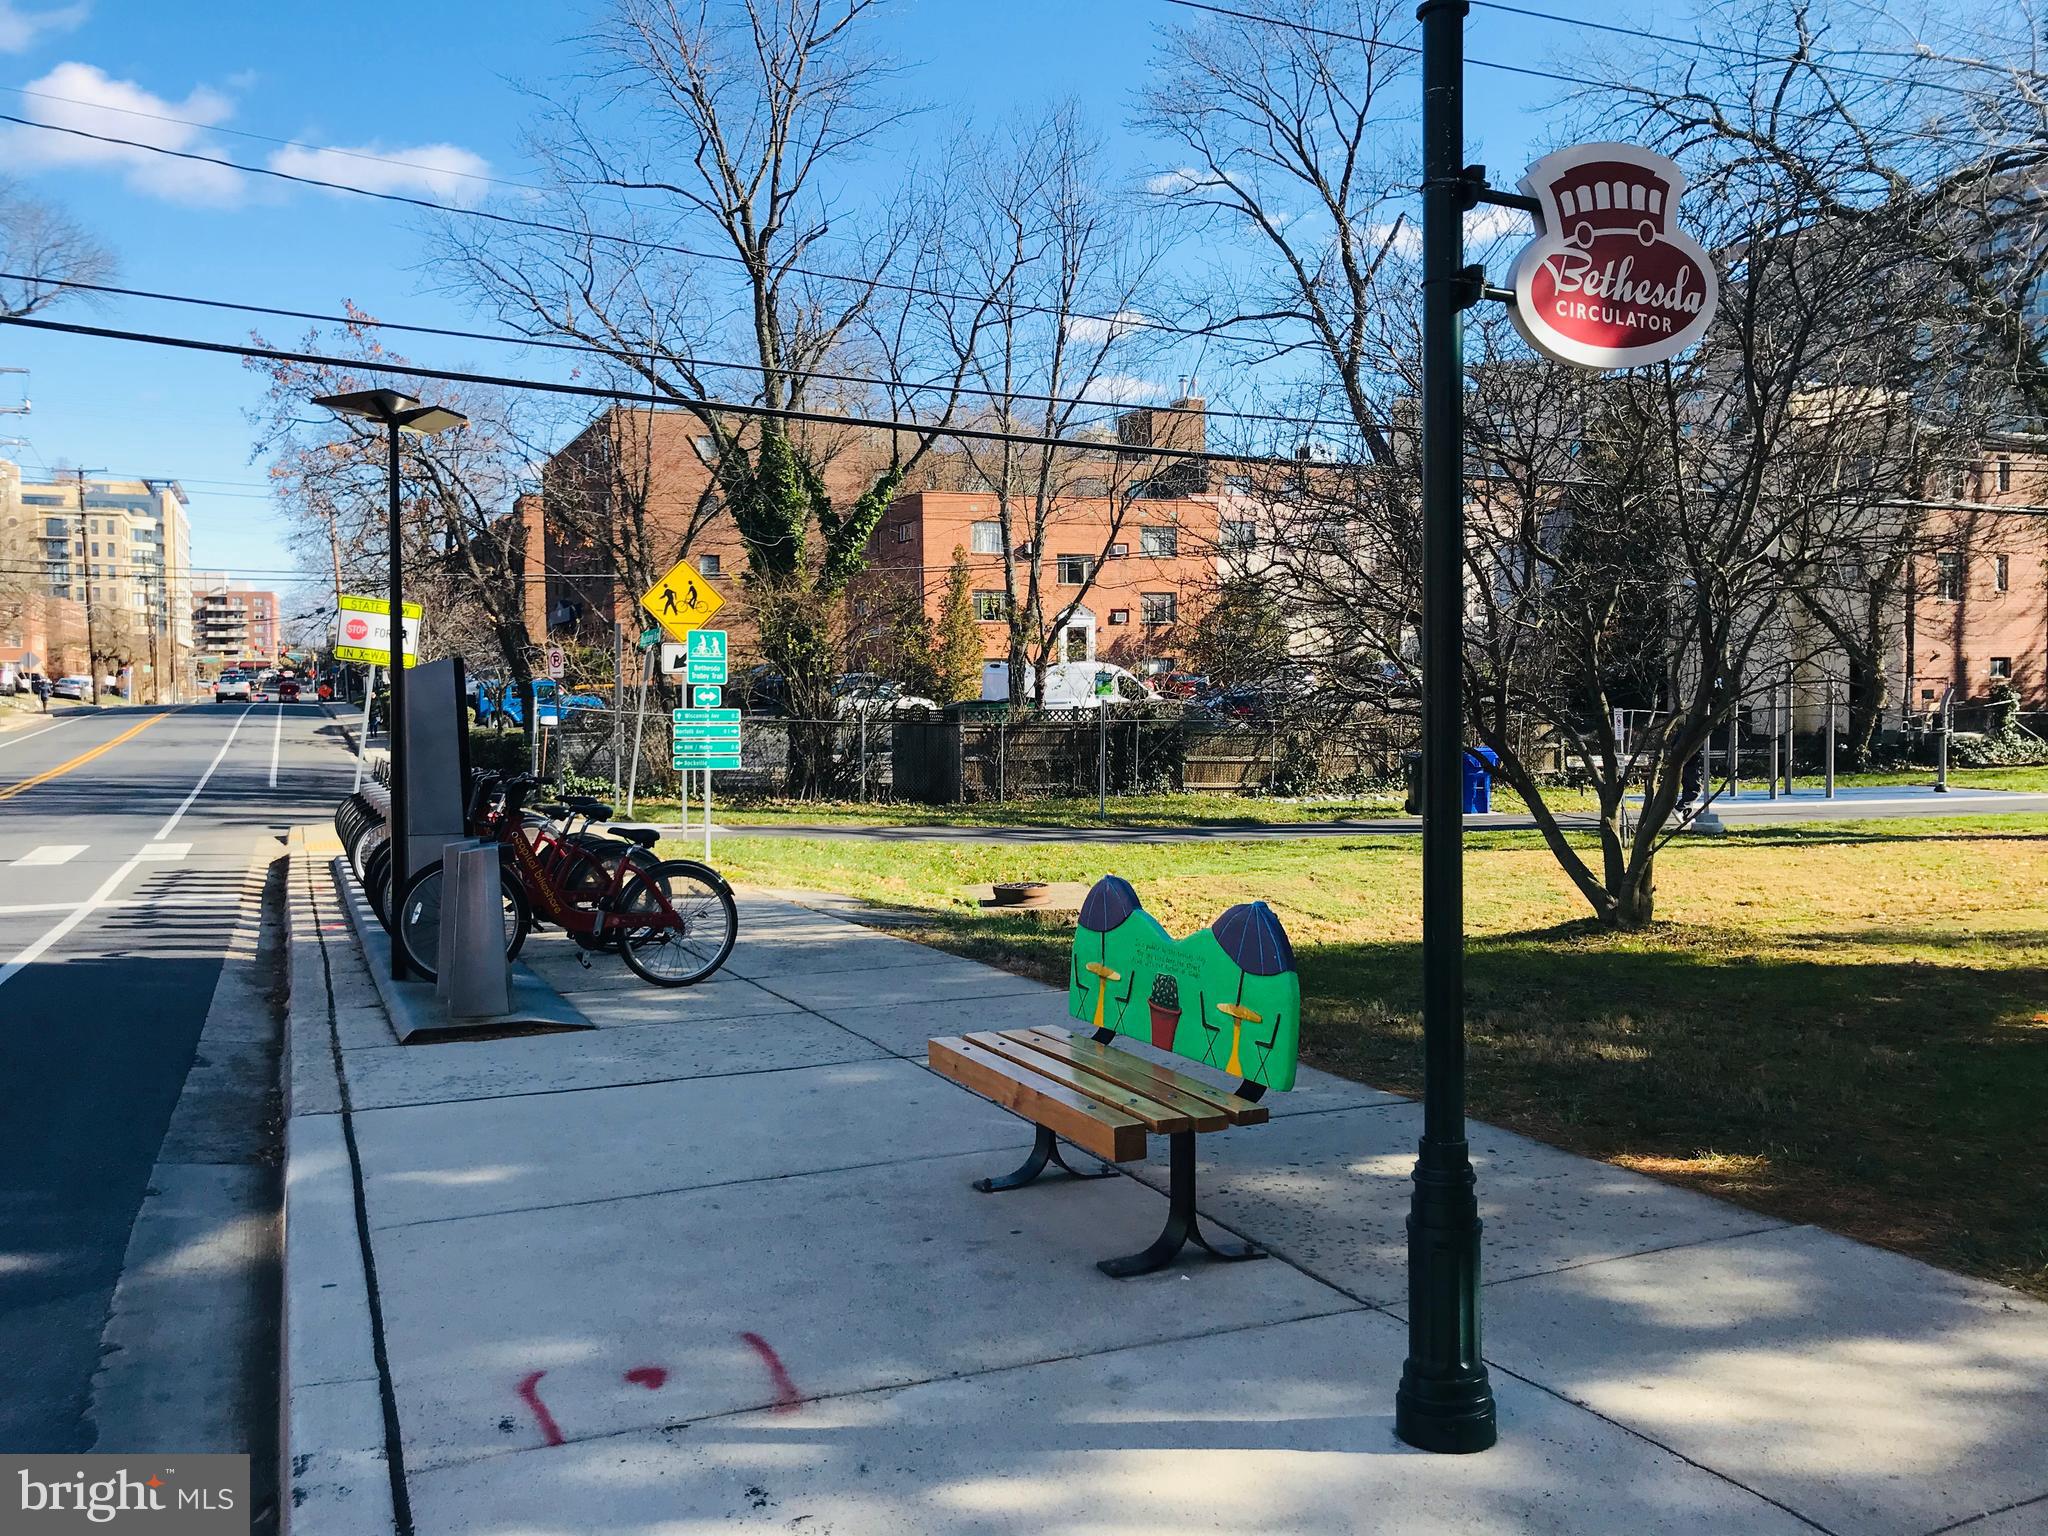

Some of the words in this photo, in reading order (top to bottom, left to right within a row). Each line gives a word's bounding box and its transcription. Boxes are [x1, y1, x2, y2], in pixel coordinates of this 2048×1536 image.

[1544, 247, 1704, 314] Bethesda
[1555, 300, 1672, 333] CIRCULATOR
[351, 601, 382, 612] STATE
[347, 624, 368, 634] STOP
[343, 648, 354, 658] IN
